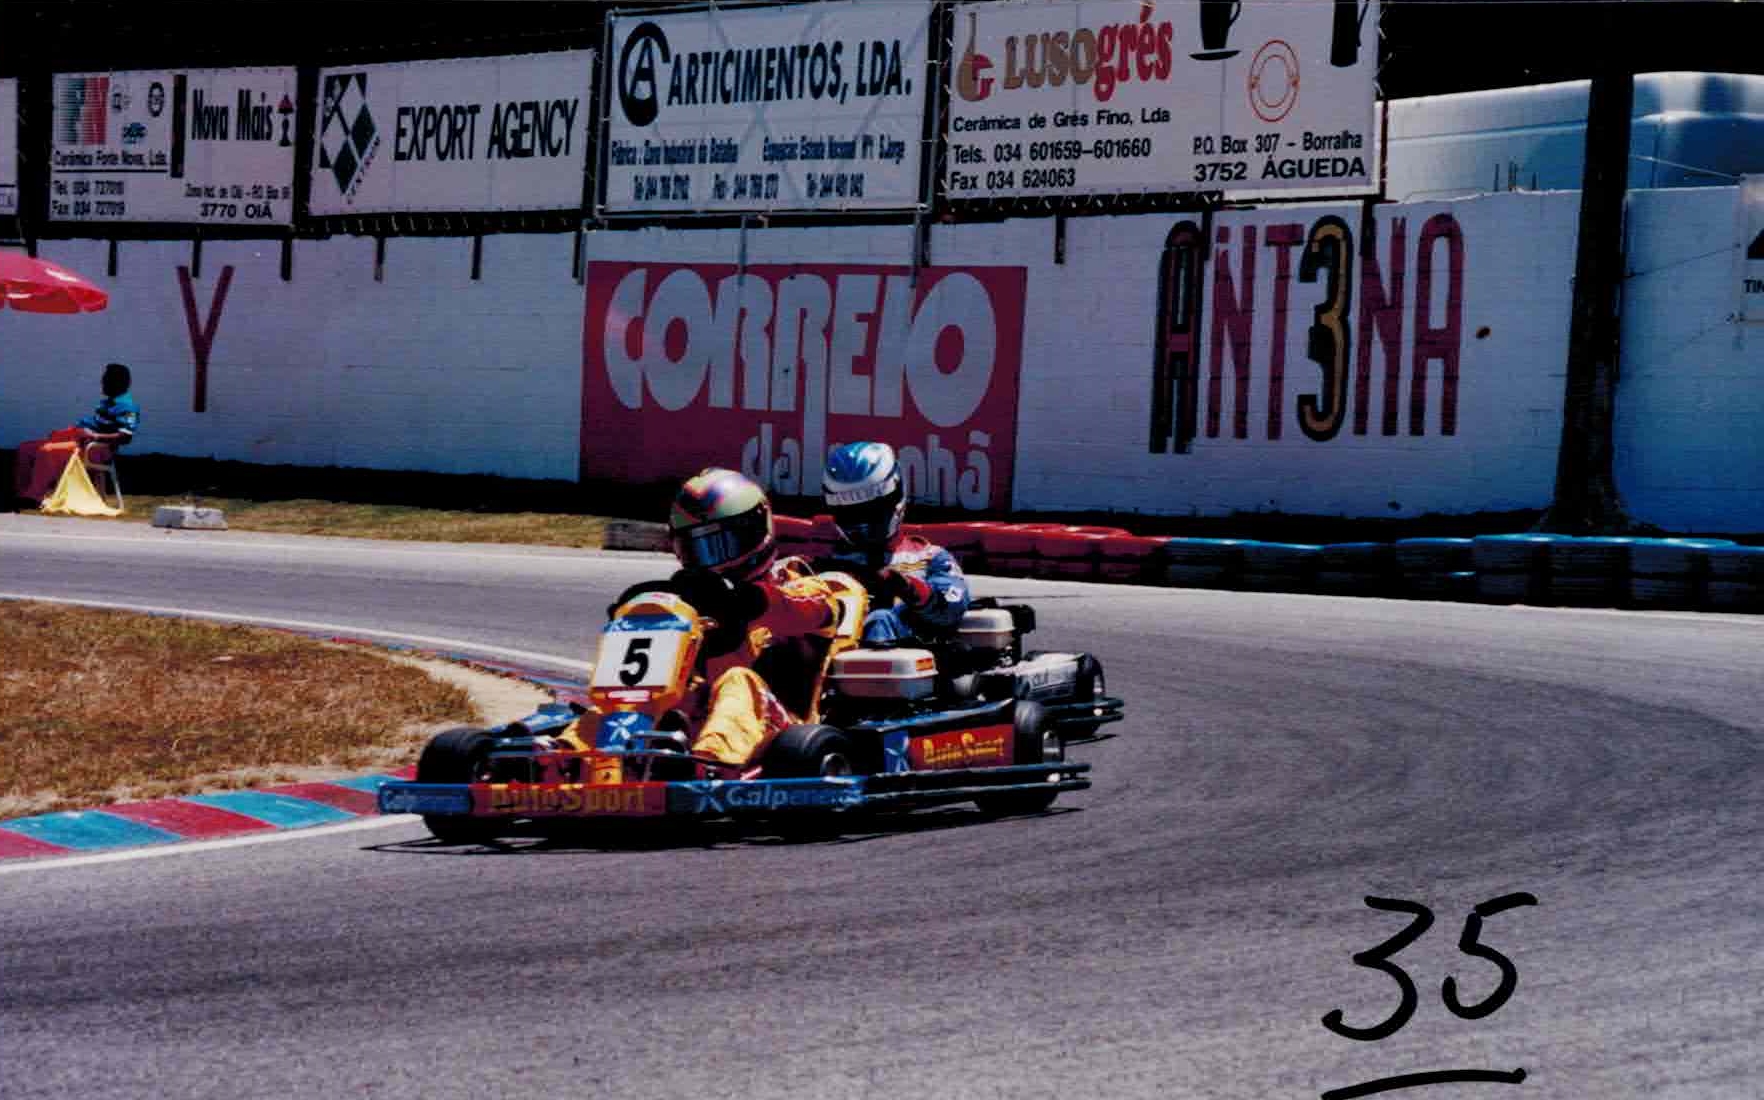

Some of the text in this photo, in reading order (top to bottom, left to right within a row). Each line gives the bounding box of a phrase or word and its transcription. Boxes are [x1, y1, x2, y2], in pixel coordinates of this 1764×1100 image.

[667, 40, 912, 106] ARTICIMENTOS, LDA.
[191, 89, 228, 140] Nova
[236, 89, 273, 140] Mais
[394, 99, 579, 161] EXPORT AGENCY
[952, 115, 1021, 132] Cerâmica
[1028, 112, 1047, 129] de
[1096, 109, 1133, 126] Fino,
[1141, 107, 1171, 124] Lda
[952, 143, 987, 164] Tels.
[994, 143, 1022, 163] 034
[1221, 135, 1248, 154] Box
[1255, 133, 1281, 153] 307
[1303, 130, 1363, 151] Borralha
[950, 168, 1076, 190] Fax 034 624063
[1193, 154, 1366, 182] 3752 ÁGUEDA
[200, 203, 237, 218] 3770
[177, 264, 235, 413] Y
[604, 267, 998, 428] CORREIO
[619, 637, 653, 686] 5
